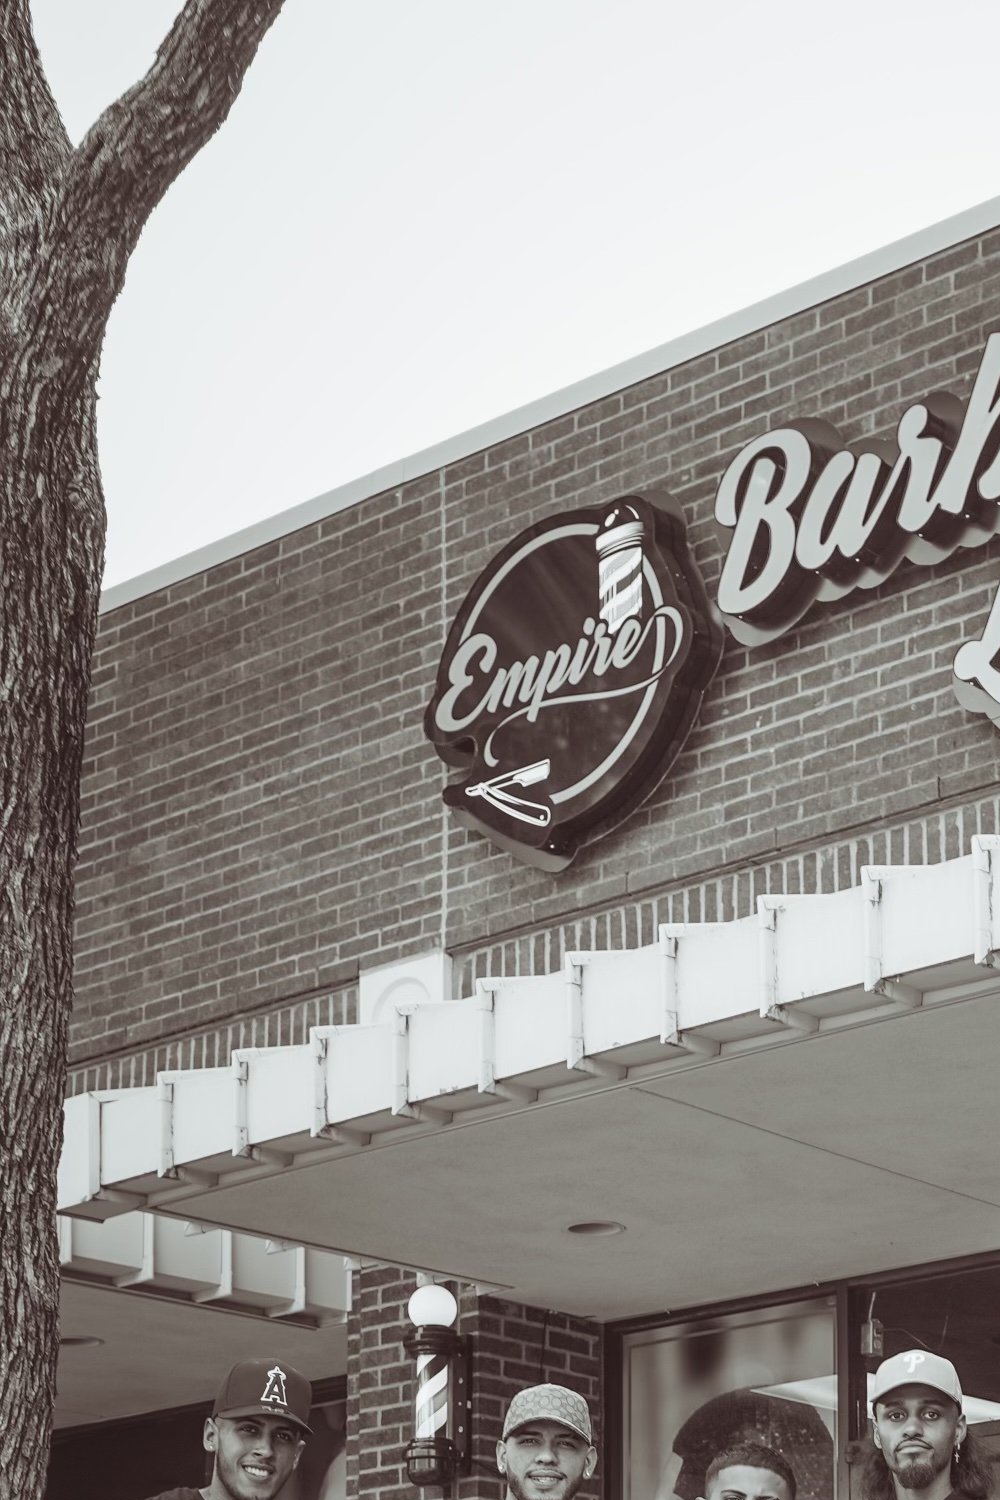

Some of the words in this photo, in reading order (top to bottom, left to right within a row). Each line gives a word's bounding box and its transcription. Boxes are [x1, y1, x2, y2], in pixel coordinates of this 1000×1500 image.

[435, 610, 666, 732] Empire
[903, 1353, 926, 1374] P
[260, 1366, 288, 1406] A
